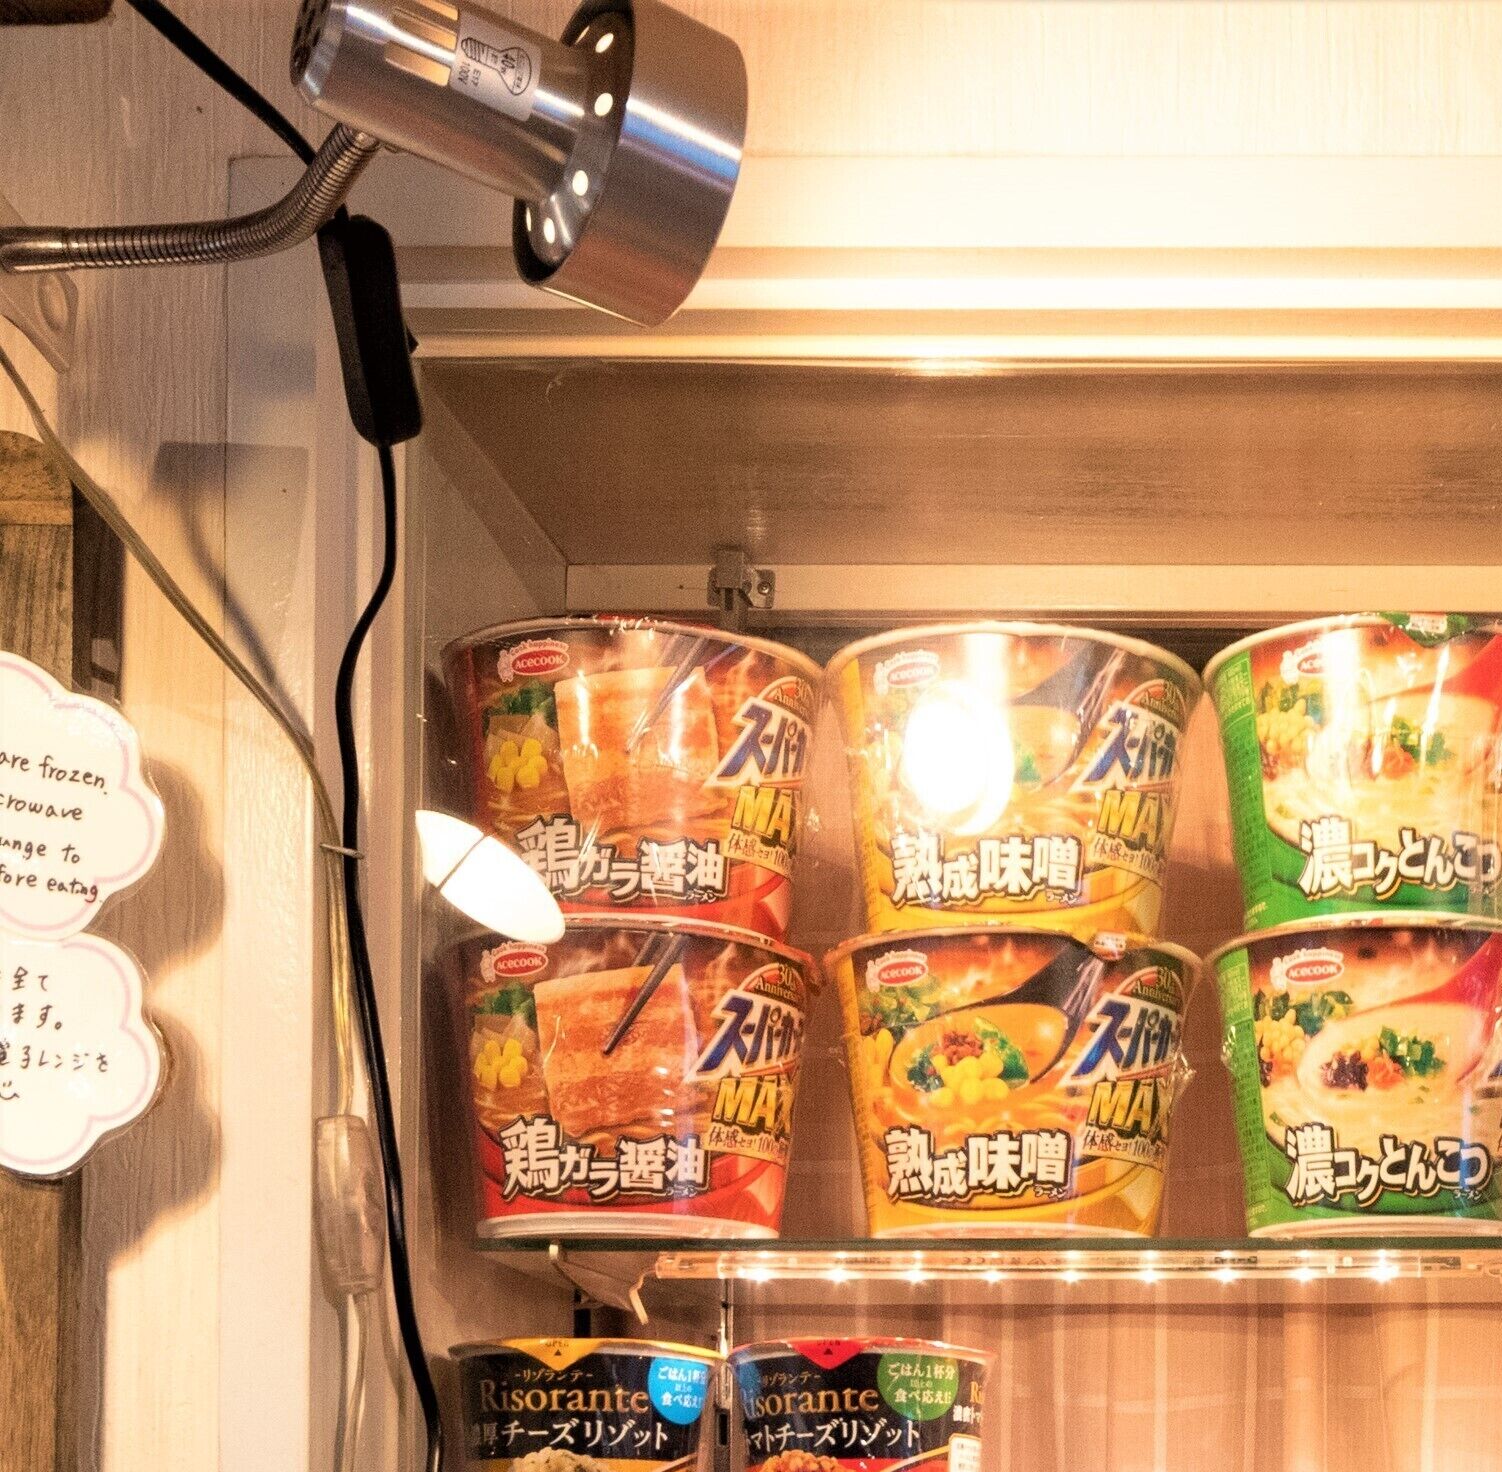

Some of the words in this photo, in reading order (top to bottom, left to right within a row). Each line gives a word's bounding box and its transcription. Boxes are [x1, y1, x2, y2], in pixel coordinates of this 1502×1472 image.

[62, 844, 81, 864] to
[891, 826, 1081, 903] 熟成味噌
[12, 966, 49, 992] 全て
[501, 1117, 709, 1201] 鶏ガラ醤油
[884, 1127, 1069, 1202] 熟成味噌
[1286, 1123, 1492, 1207] 濃コクとんこつ
[479, 1379, 650, 1414] Risorante
